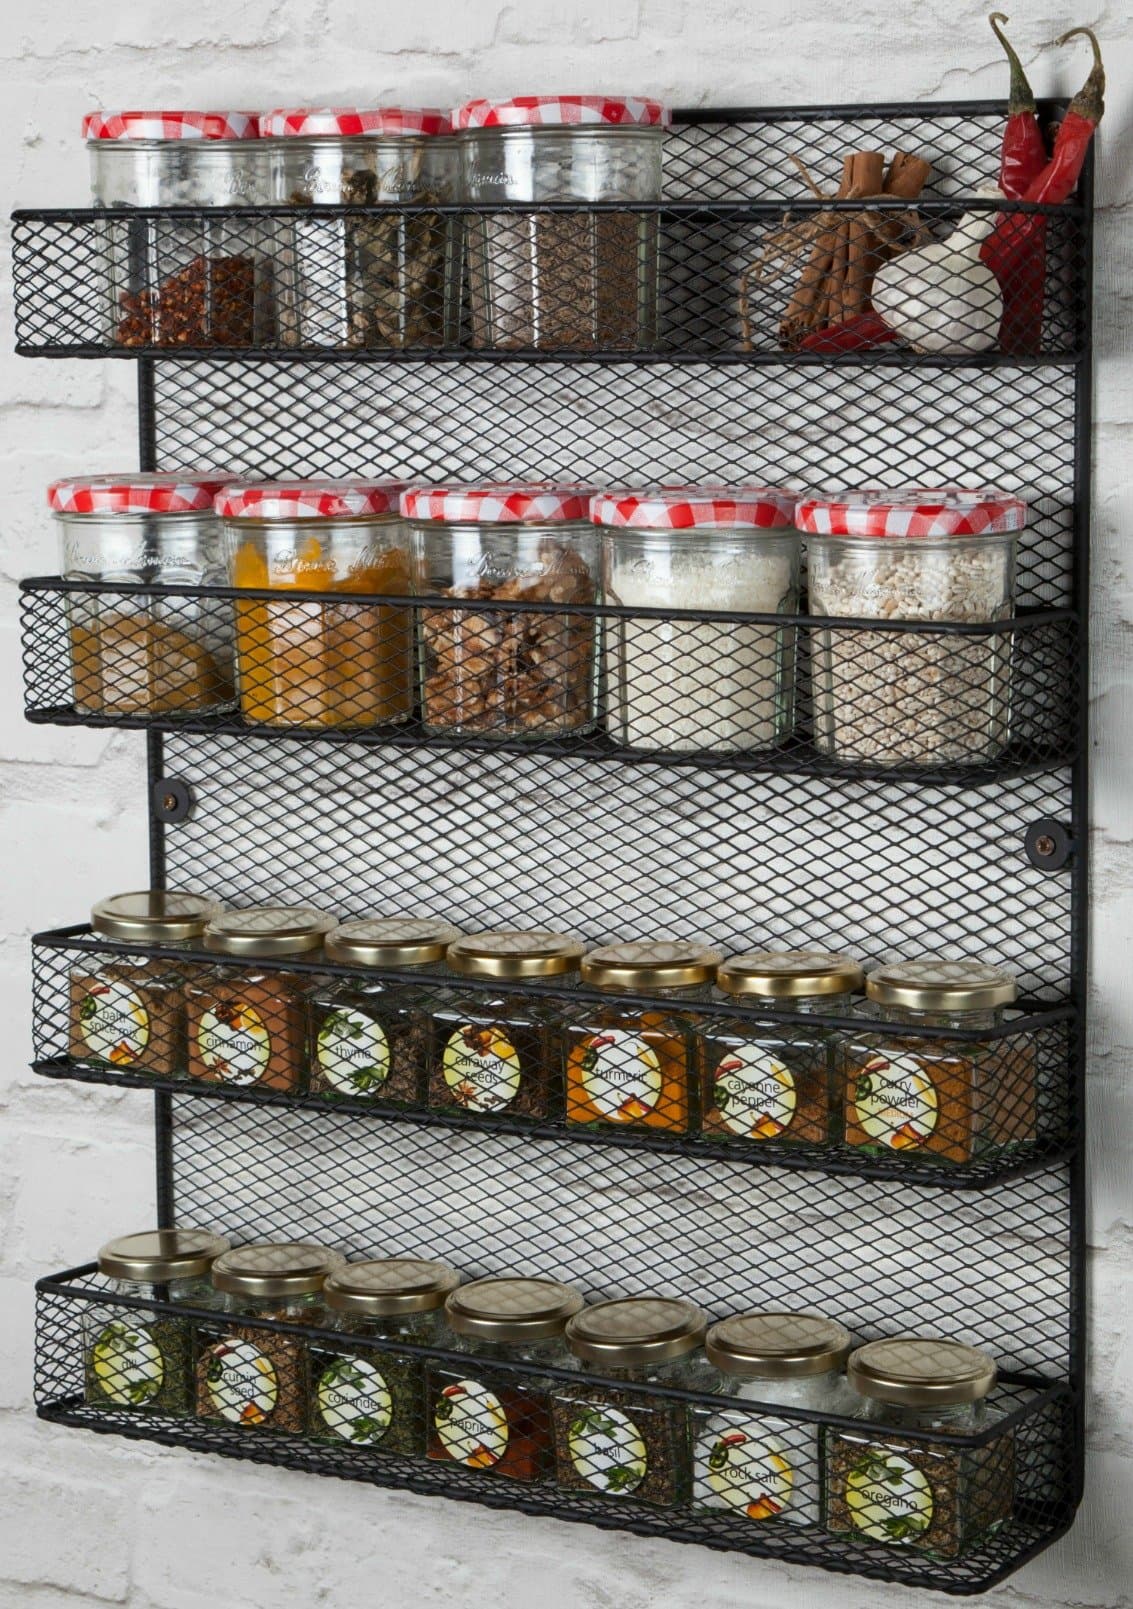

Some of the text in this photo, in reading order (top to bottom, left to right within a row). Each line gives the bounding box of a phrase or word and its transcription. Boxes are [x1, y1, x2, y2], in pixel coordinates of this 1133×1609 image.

[206, 1036, 262, 1052] cinnamon
[335, 1045, 371, 1061] thyme
[456, 1056, 505, 1074] caraway
[465, 1071, 498, 1086] seeds
[728, 1080, 780, 1094] cayenne
[731, 1095, 777, 1110] pepper
[870, 1092, 920, 1108] powder
[223, 1371, 257, 1385] cumin
[230, 1383, 255, 1400] seed
[450, 1416, 493, 1437] paprika
[724, 1466, 778, 1485] rock salt
[862, 1489, 918, 1510] oregano
